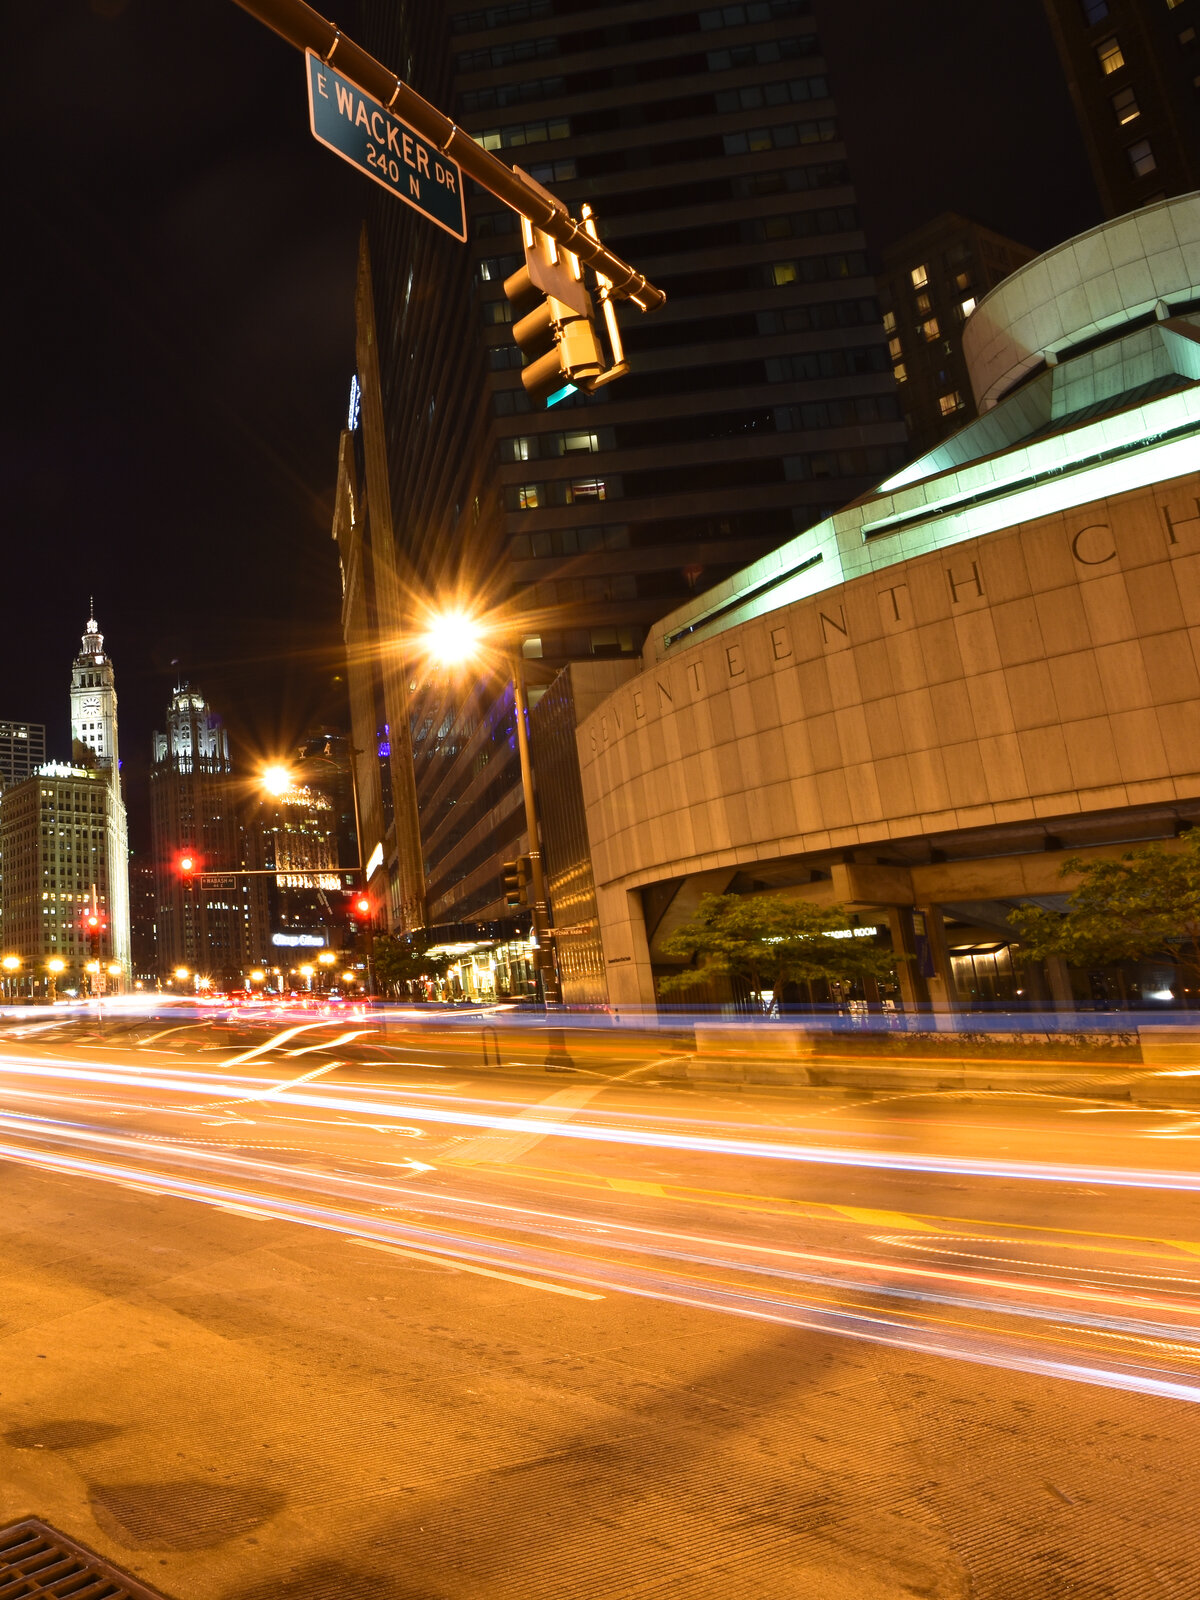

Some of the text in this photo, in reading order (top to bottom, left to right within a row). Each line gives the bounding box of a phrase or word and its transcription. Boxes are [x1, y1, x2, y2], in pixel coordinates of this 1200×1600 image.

[316, 72, 456, 194] E WACKER DR
[366, 143, 420, 200] 240 N
[589, 560, 986, 752] SEVENTEENTH
[854, 927, 878, 938] ROOM
